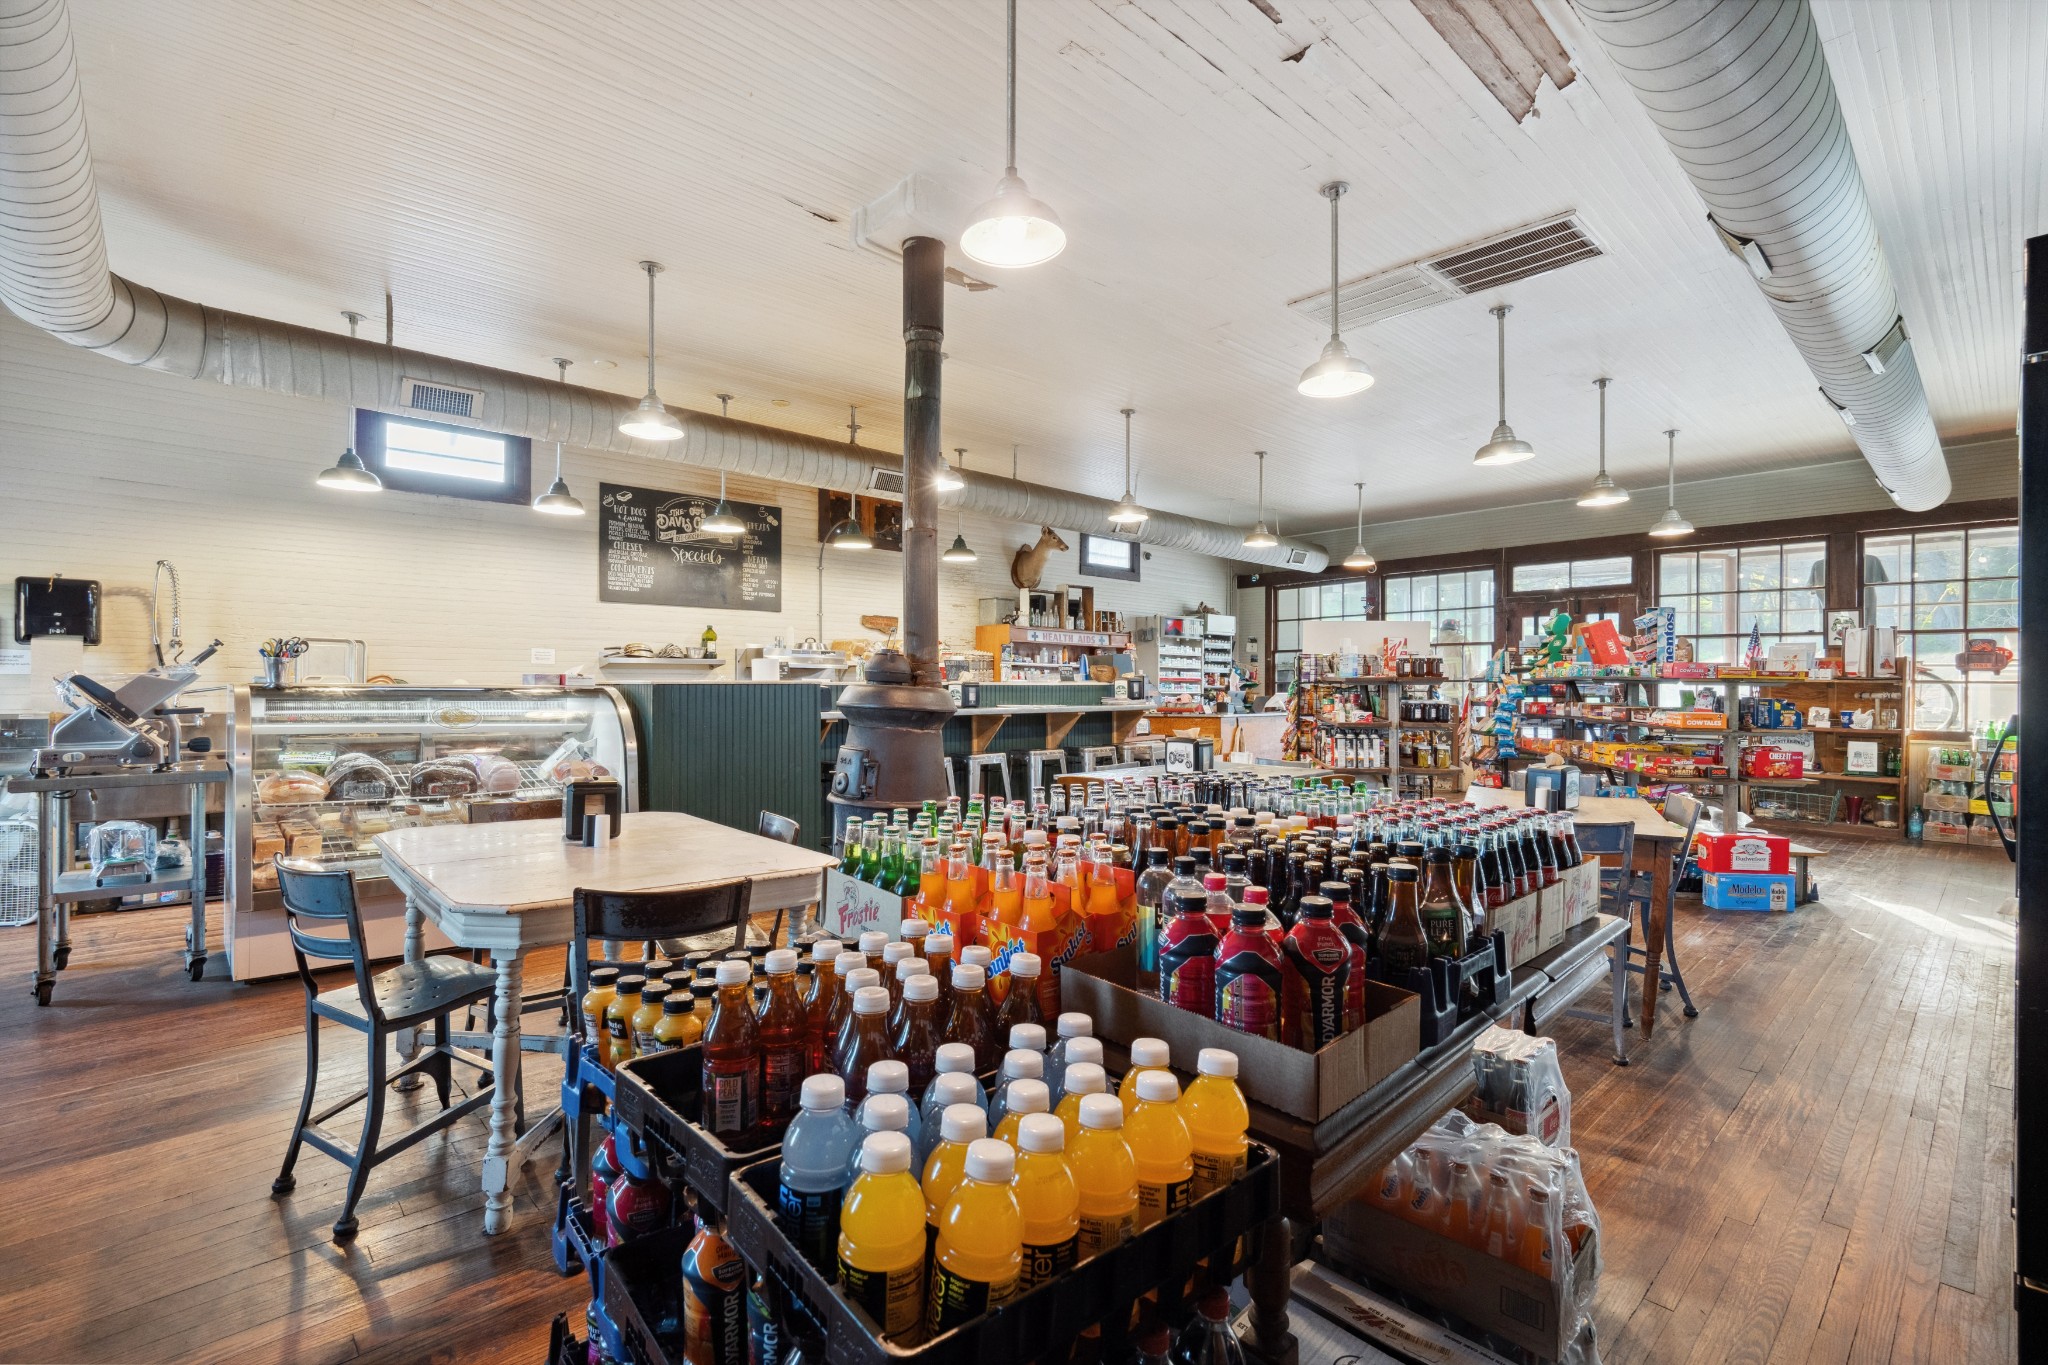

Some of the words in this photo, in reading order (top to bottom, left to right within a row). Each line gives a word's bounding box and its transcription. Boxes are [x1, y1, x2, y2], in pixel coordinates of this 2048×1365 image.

[656, 513, 693, 533] DAVIS
[614, 541, 643, 552] CHEESES
[670, 546, 726, 565] Specials
[610, 564, 656, 575] CONDIMENTS
[1042, 632, 1074, 642] HEALTH
[1078, 636, 1096, 644] AIDS
[1768, 752, 1792, 760] CHEEZ-IT
[1674, 768, 1694, 776] HEATH
[1732, 884, 1762, 894] Modelo
[838, 898, 880, 934] Frostie
[1430, 920, 1454, 928] PURE
[1430, 928, 1454, 937] LEAF
[1050, 920, 1086, 976] Sunkist
[1322, 976, 1336, 1042] DYARMOR
[720, 1080, 738, 1089] GOLD
[720, 1089, 738, 1098] PEAK
[718, 1262, 742, 1275] SUPERIOR
[1034, 1249, 1052, 1283] ter
[850, 1270, 868, 1280] tropical
[950, 1276, 970, 1289] tropical
[949, 1284, 964, 1294] citrus
[1386, 1316, 1406, 1329] SINCE
